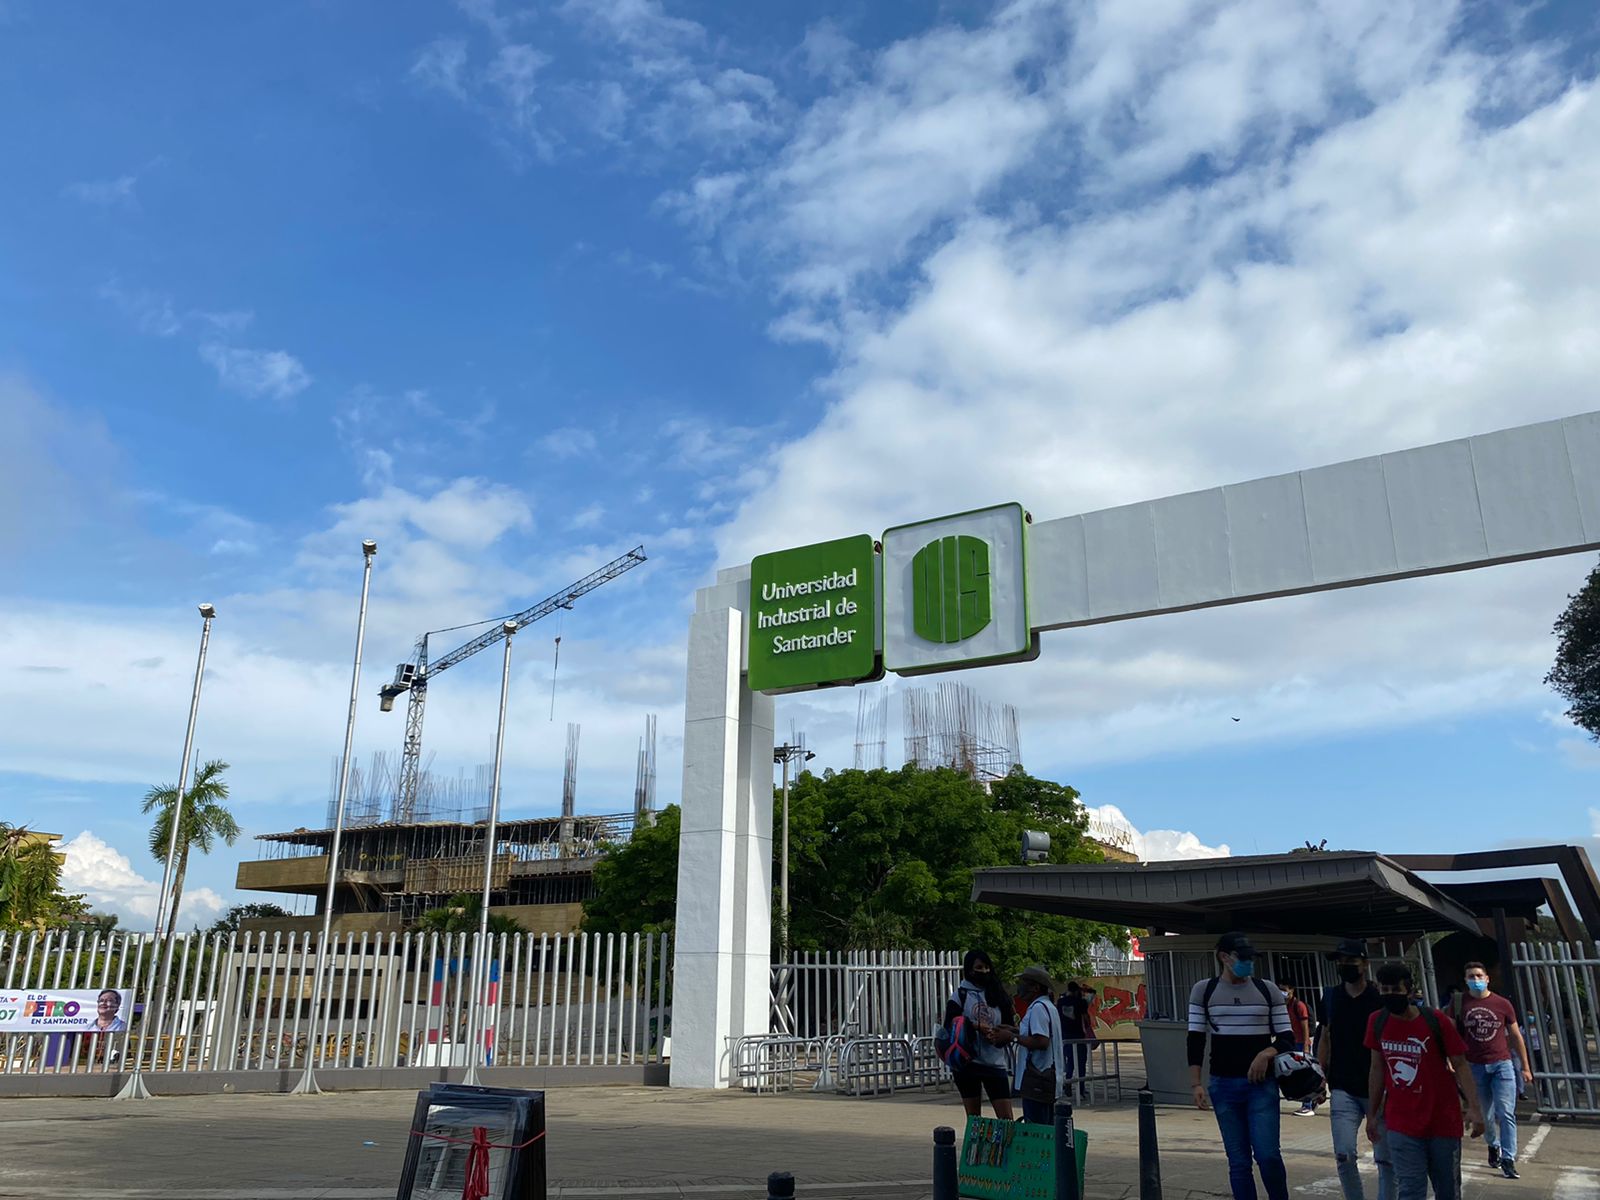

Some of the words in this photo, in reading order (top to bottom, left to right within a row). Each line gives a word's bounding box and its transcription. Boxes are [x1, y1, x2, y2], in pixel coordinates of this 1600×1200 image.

[762, 568, 857, 601] Universidad
[758, 600, 830, 629] Industrial
[835, 597, 857, 616] de
[773, 627, 856, 654] Santander
[23, 1001, 80, 1017] PETRO
